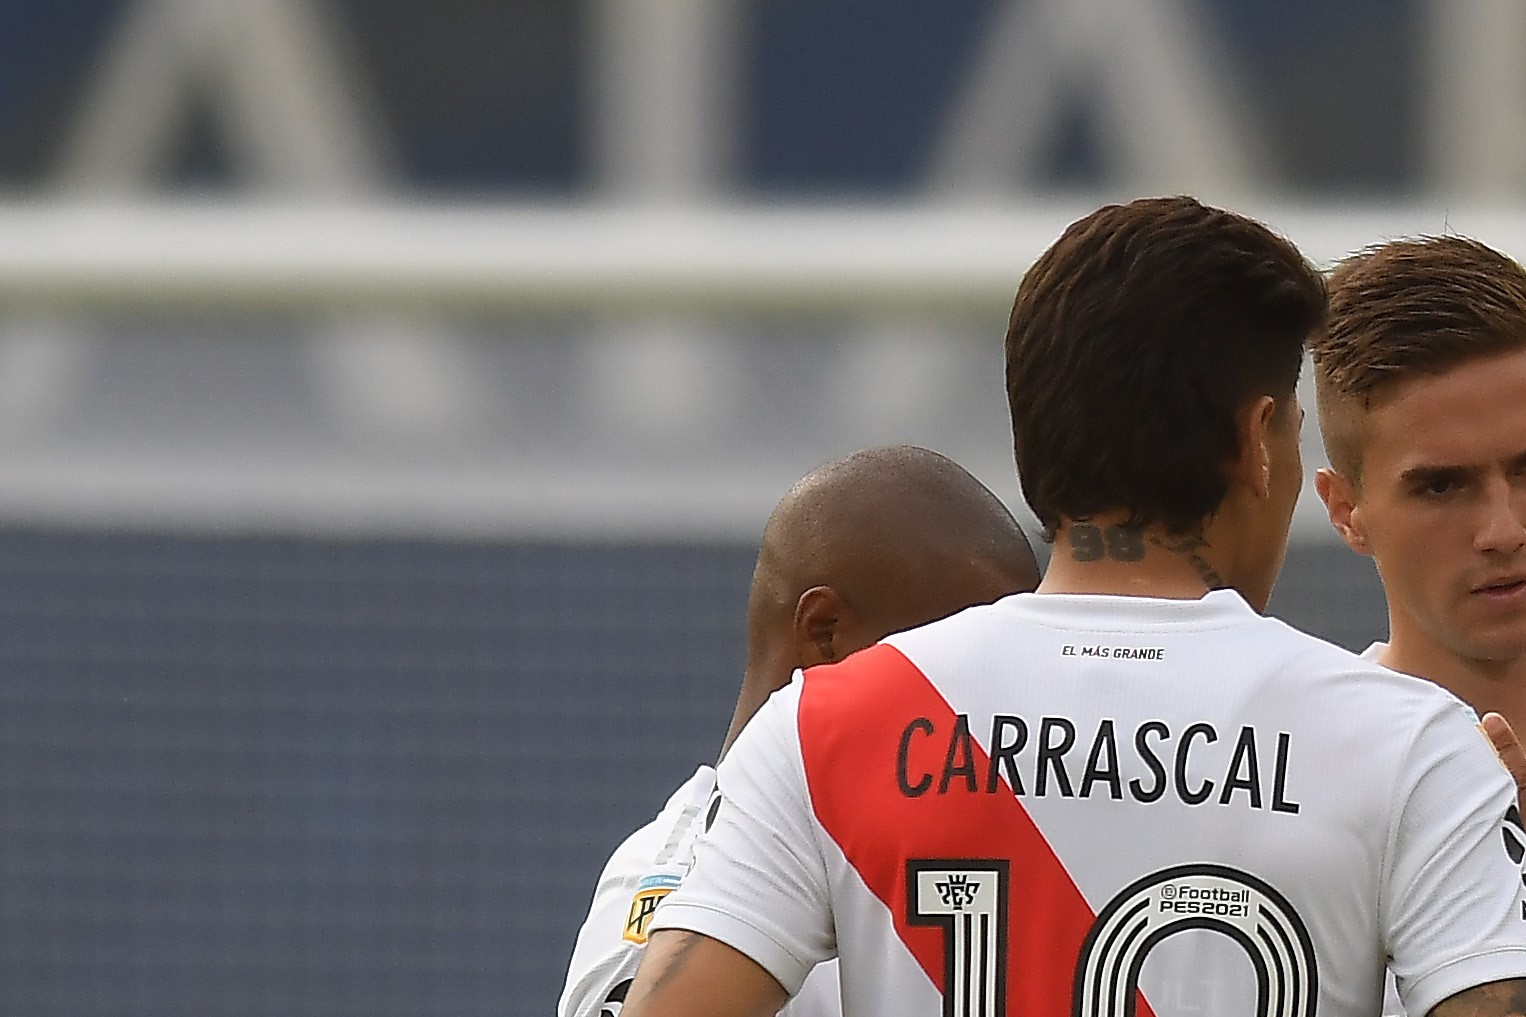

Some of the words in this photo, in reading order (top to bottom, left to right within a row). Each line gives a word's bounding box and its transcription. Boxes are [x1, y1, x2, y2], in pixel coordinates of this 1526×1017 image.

[1061, 645, 1077, 656] EL
[1081, 645, 1110, 658] MÁS
[1113, 647, 1165, 660] GRANDE
[898, 713, 1300, 815] CARRASCAL
